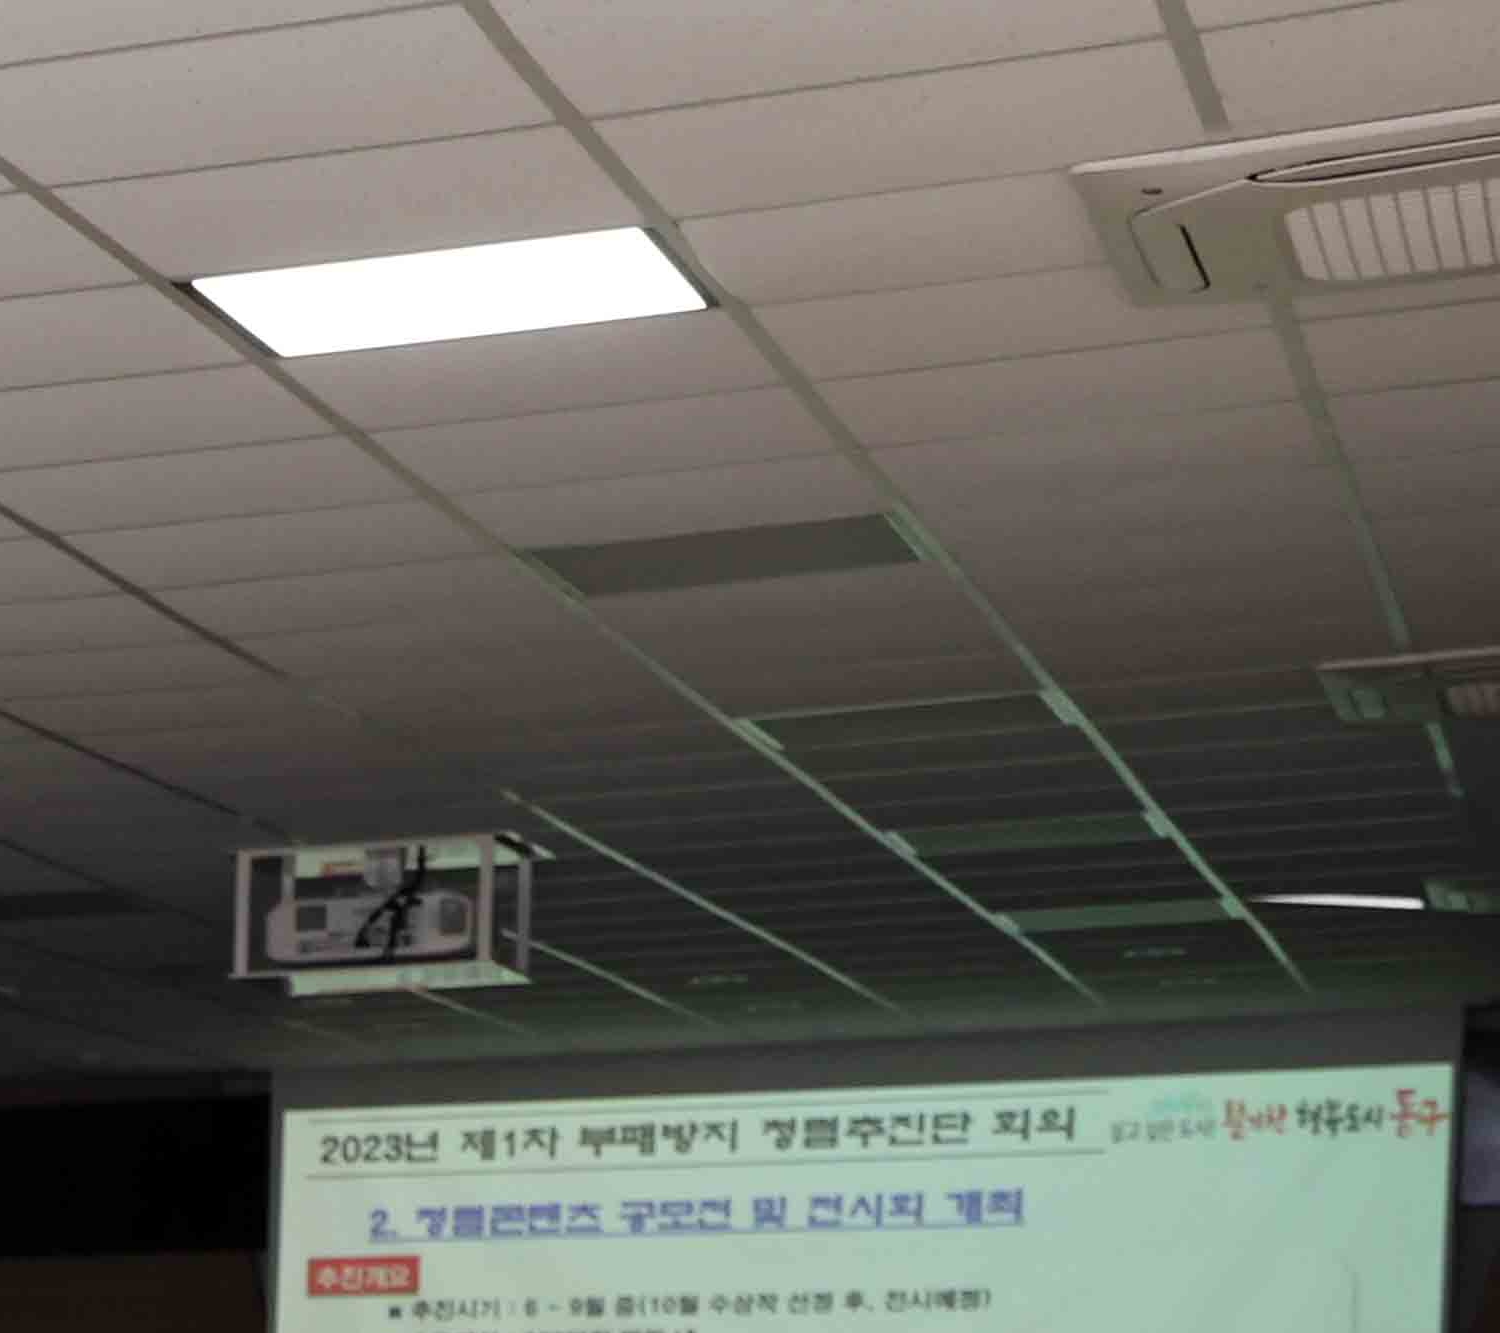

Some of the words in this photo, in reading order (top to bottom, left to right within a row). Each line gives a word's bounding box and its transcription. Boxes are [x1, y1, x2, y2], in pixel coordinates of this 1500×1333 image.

[320, 1131, 439, 1164] 2023년
[461, 1127, 561, 1160] 제1차
[580, 1119, 738, 1157] 부패방지
[763, 1110, 972, 1150] 청렴추진단
[993, 1106, 1075, 1141] 회의
[1391, 1087, 1450, 1138] 동구
[316, 1263, 412, 1291] 추진개요
